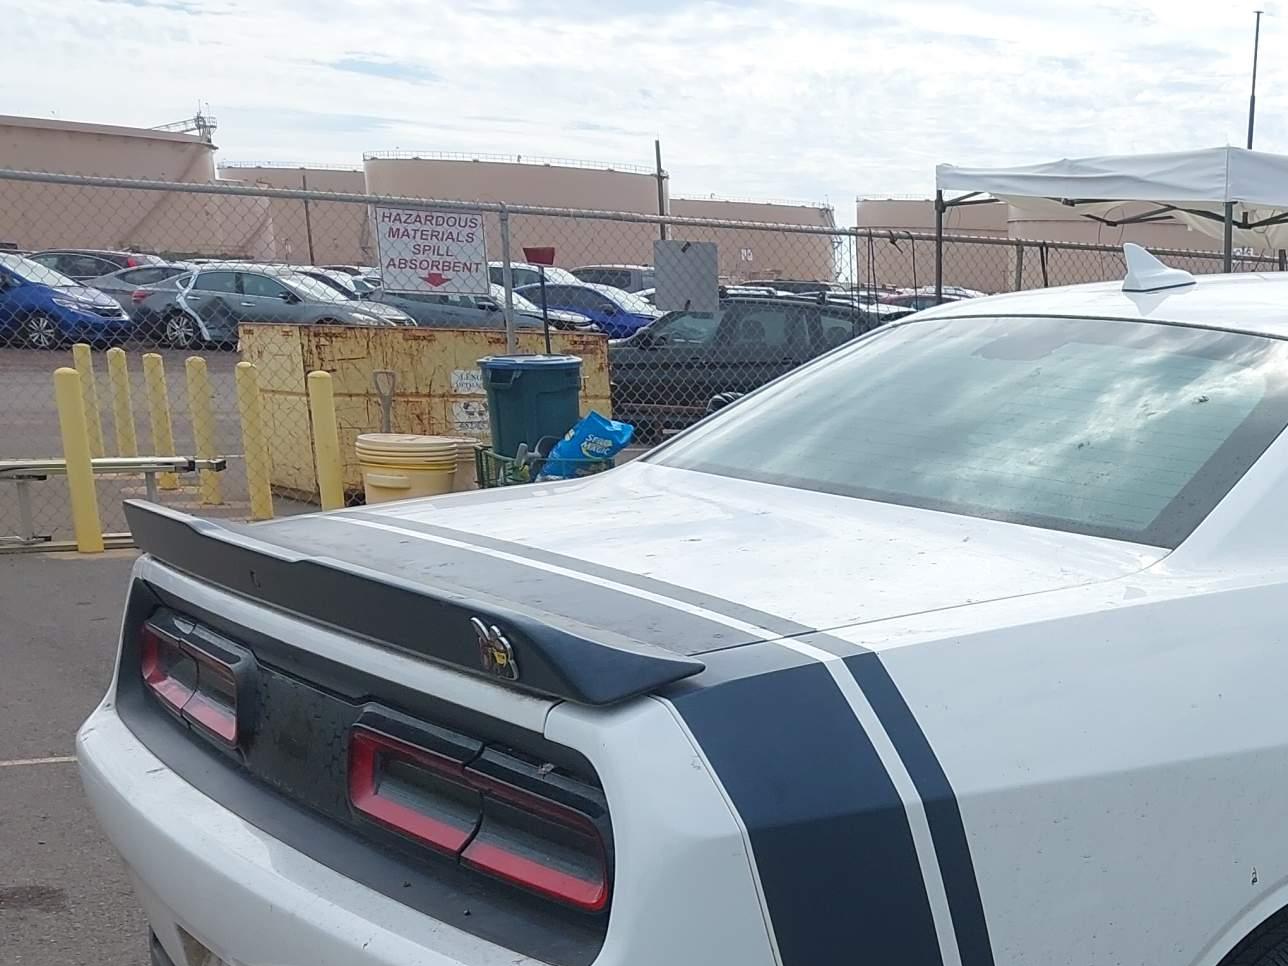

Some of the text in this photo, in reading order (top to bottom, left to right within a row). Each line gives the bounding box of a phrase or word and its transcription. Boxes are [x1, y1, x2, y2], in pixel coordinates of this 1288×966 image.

[382, 211, 478, 228] HAZARDOUS
[388, 227, 475, 243] MATERIALS
[412, 244, 454, 257] SPILL
[386, 258, 482, 273] ABSORBENT
